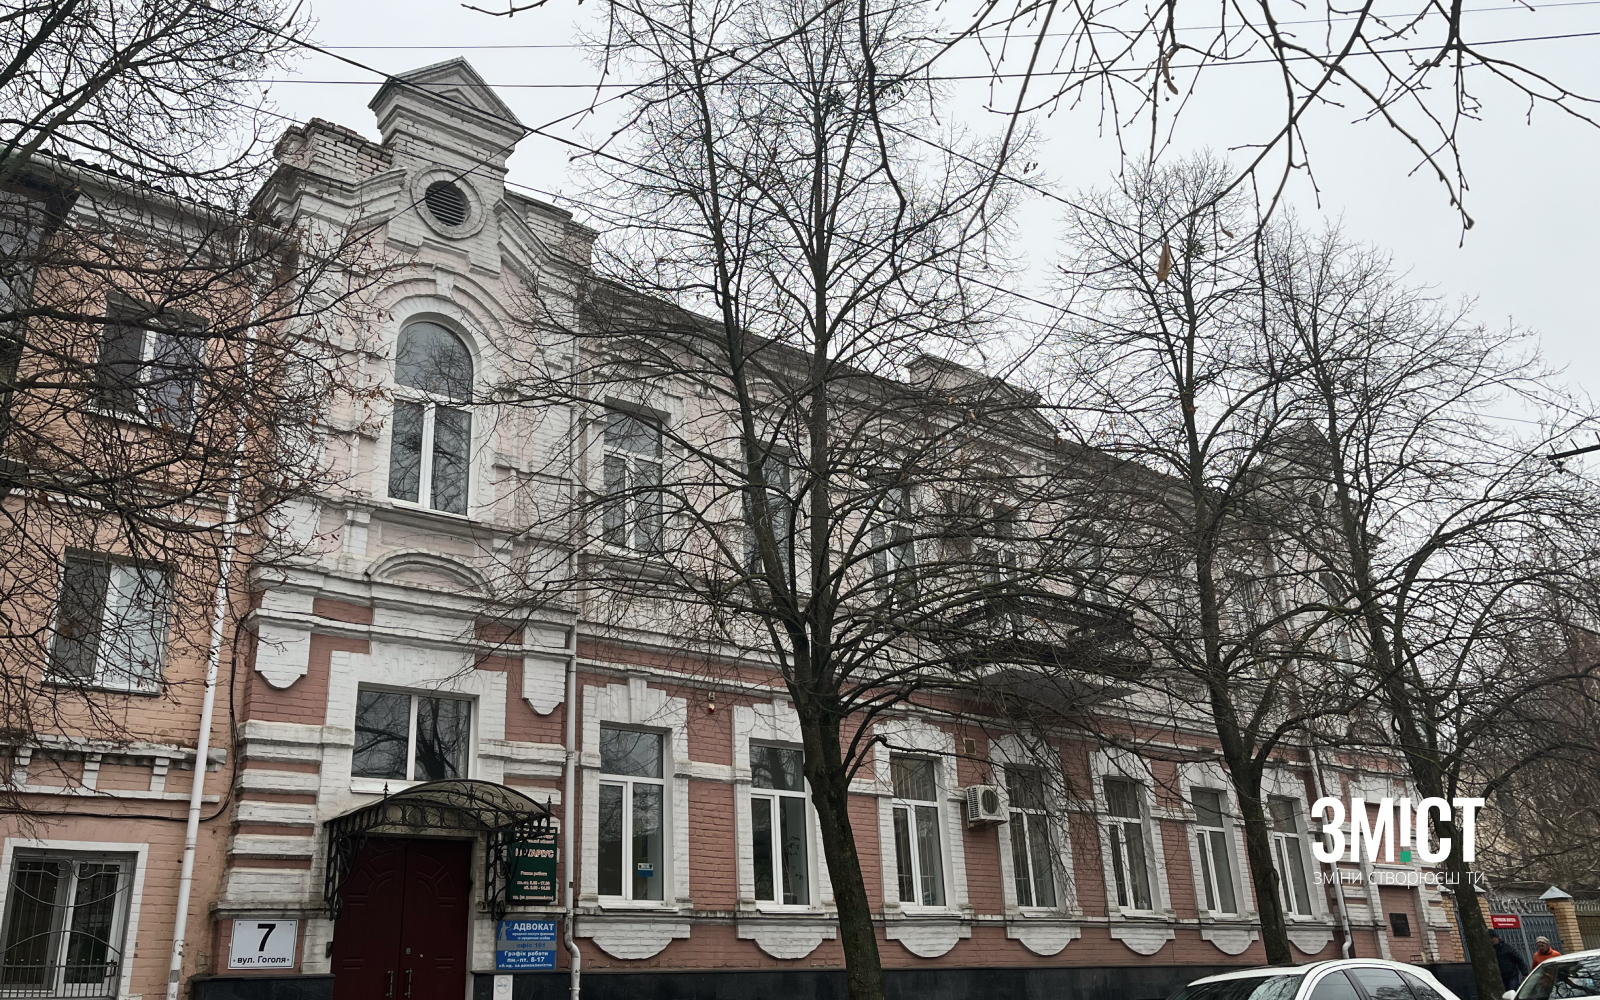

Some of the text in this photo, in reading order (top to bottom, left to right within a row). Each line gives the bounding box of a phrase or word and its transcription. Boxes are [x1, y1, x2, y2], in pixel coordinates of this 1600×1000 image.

[513, 923, 554, 932] АДВОКАТ
[257, 923, 276, 952] 7
[237, 955, 286, 965] вул. Гоголя
